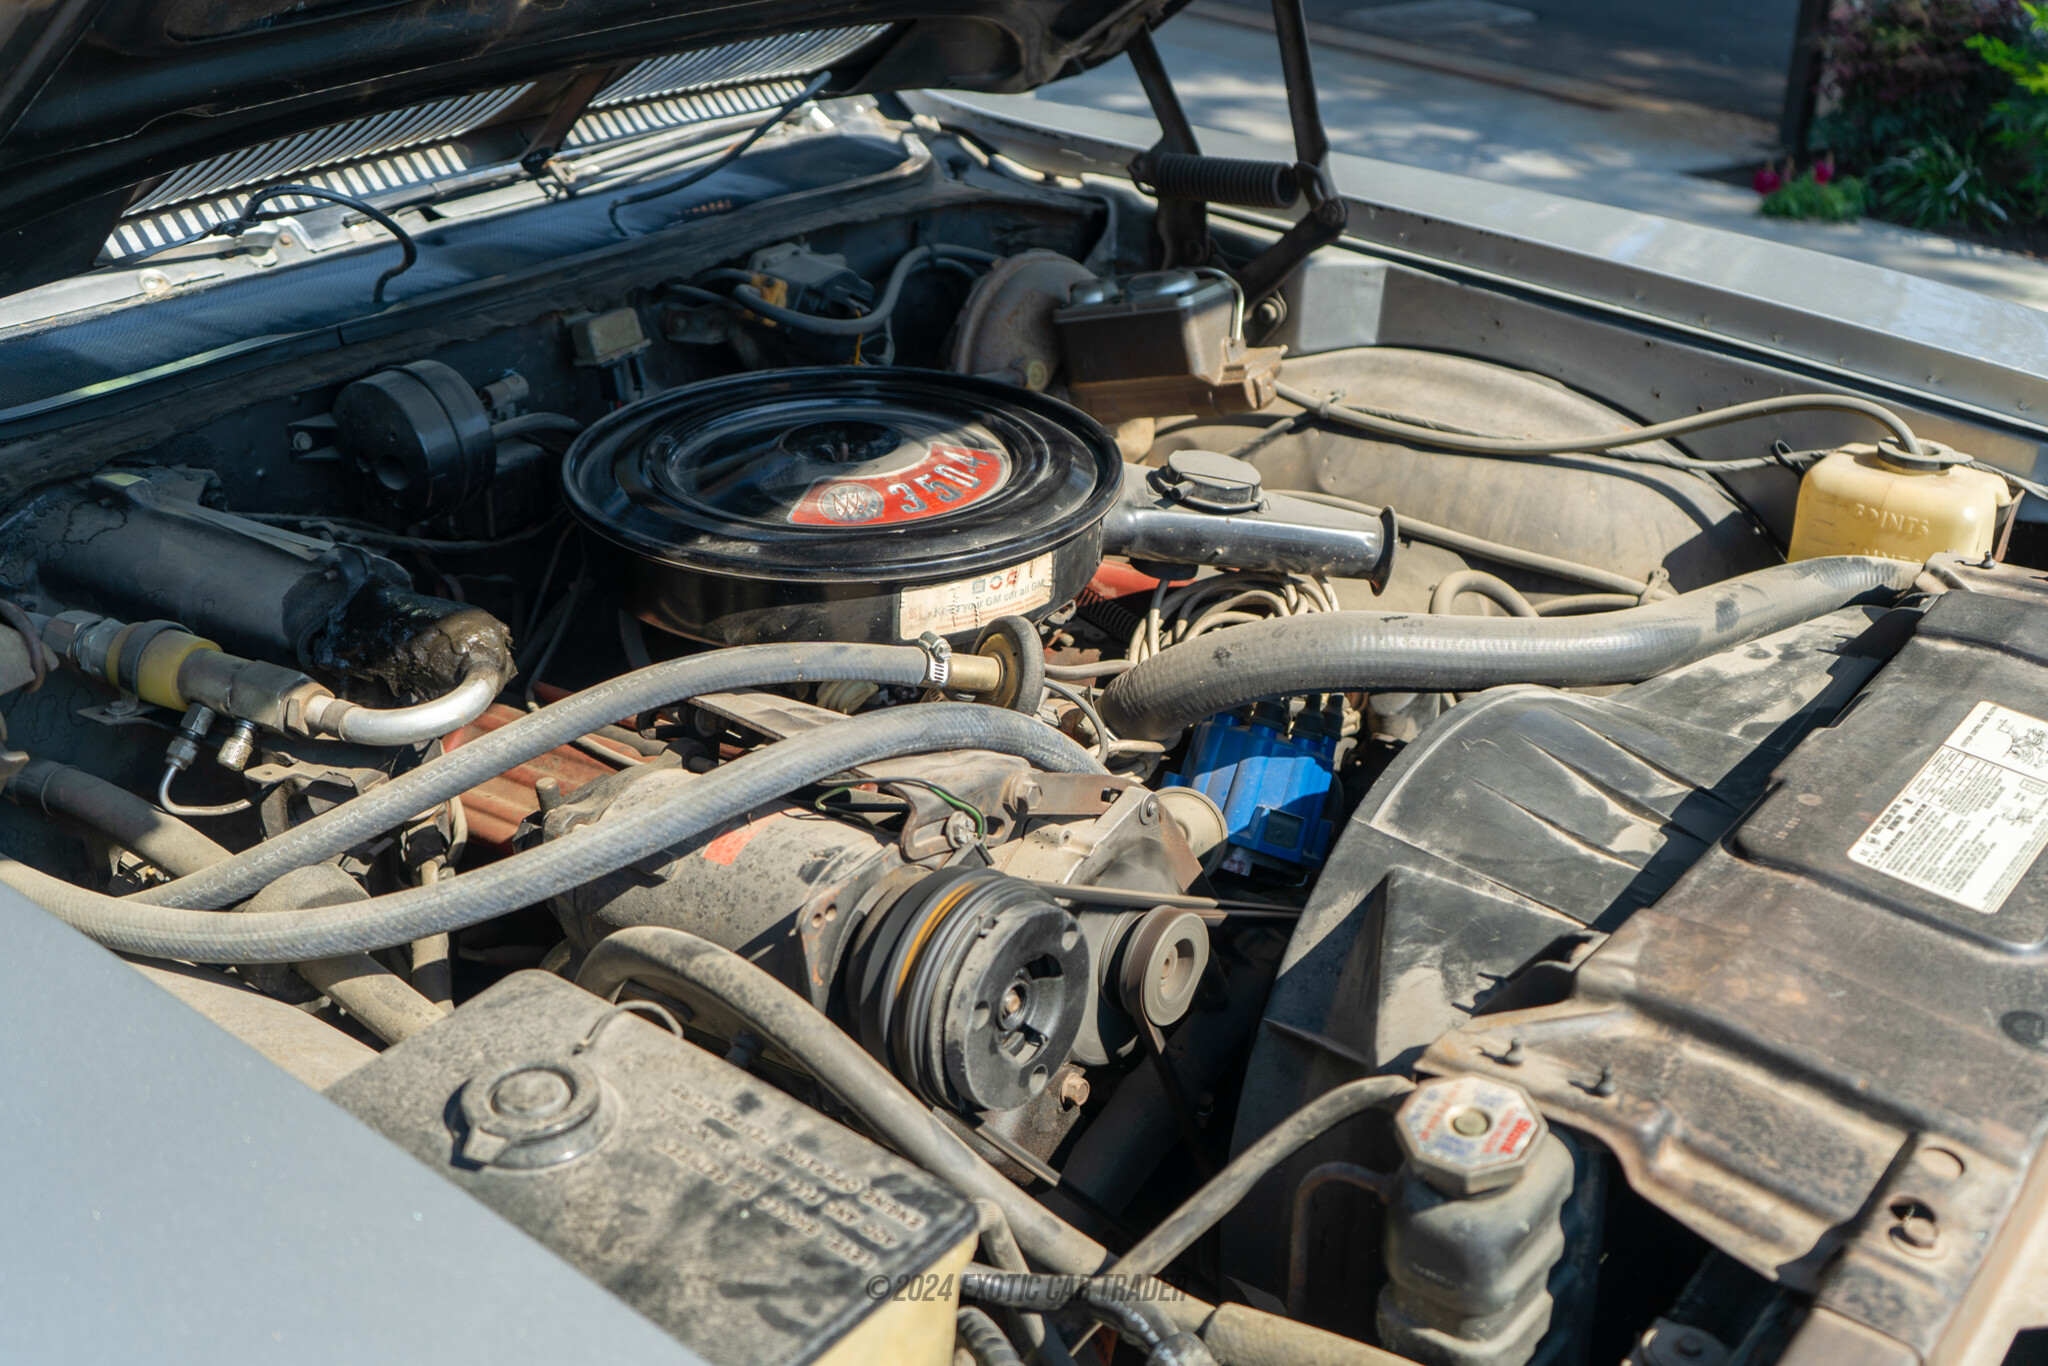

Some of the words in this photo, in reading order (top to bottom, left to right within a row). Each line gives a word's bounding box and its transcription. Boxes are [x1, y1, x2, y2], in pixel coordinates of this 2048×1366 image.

[986, 594, 1001, 606] GM
[1004, 590, 1017, 601] car
[1019, 584, 1029, 596] all
[616, 671, 654, 691] INCH
[485, 714, 555, 751] PREMIUM
[417, 747, 482, 787] HEATER
[368, 784, 412, 814] HOSE
[312, 808, 363, 840] MADE
[293, 834, 309, 850] IN
[252, 846, 288, 866] USA
[226, 866, 249, 883] BY
[188, 881, 219, 899] THE
[862, 1189, 921, 1228] ENGINE
